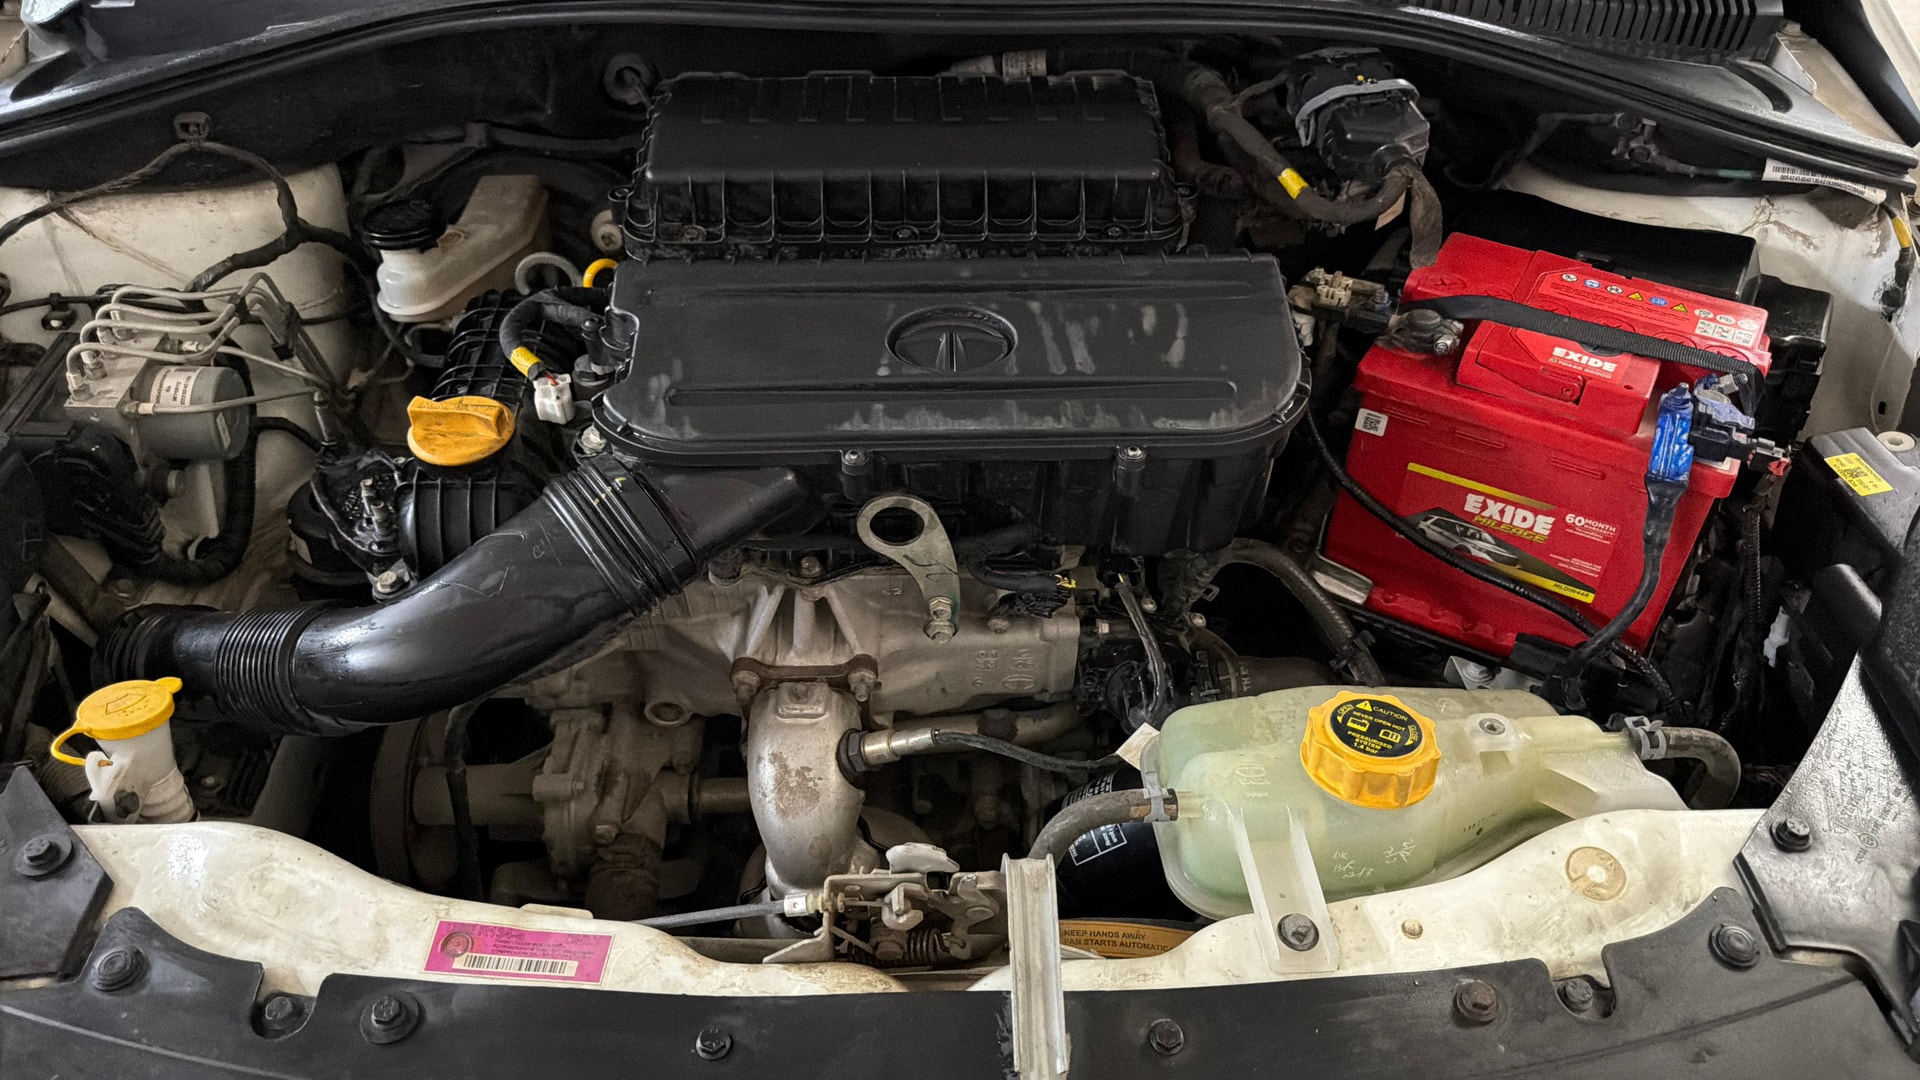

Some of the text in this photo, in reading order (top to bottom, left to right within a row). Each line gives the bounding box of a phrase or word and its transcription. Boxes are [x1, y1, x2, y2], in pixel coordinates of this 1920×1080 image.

[1552, 347, 1618, 373] EXIDE
[1463, 493, 1556, 536] EXIDE
[1565, 513, 1585, 527] 60
[1584, 519, 1617, 533] MONTH
[1473, 514, 1549, 544] MILEAGE
[1337, 704, 1353, 715] OPEN
[1373, 706, 1408, 722] CAUTION
[1352, 711, 1406, 731] NEVER OPEN HOT
[1347, 731, 1393, 750] PRESSURISED
[1409, 724, 1419, 742] CLOSE
[1354, 738, 1382, 750] SYSTEM
[1365, 746, 1379, 754] bar
[1064, 929, 1146, 941] KEEP HANDS AWAY
[1064, 938, 1082, 946] FAN
[1083, 939, 1117, 947] STARTS
